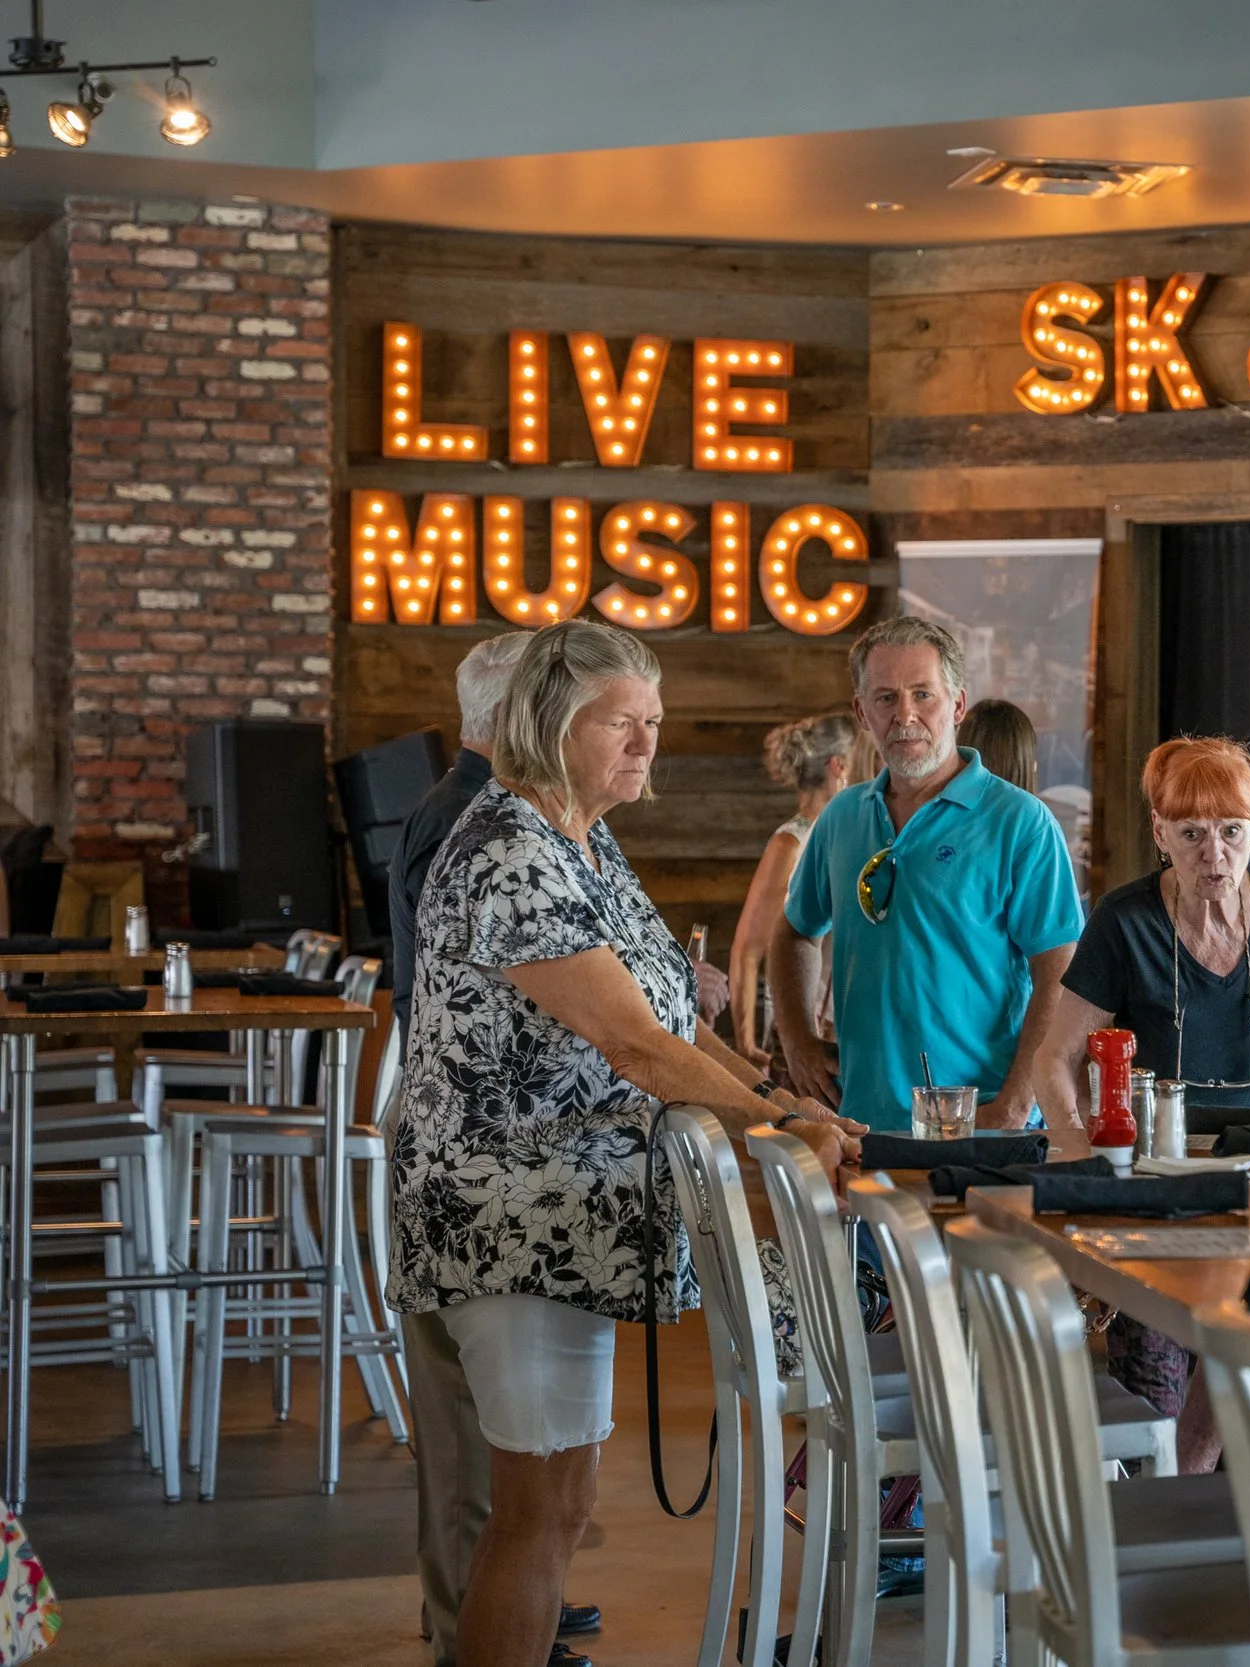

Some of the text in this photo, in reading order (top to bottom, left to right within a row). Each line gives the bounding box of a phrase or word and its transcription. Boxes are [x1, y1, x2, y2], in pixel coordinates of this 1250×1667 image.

[383, 321, 794, 473] LIVE
[1014, 272, 1207, 414] SK
[350, 489, 869, 636] MUSIC
